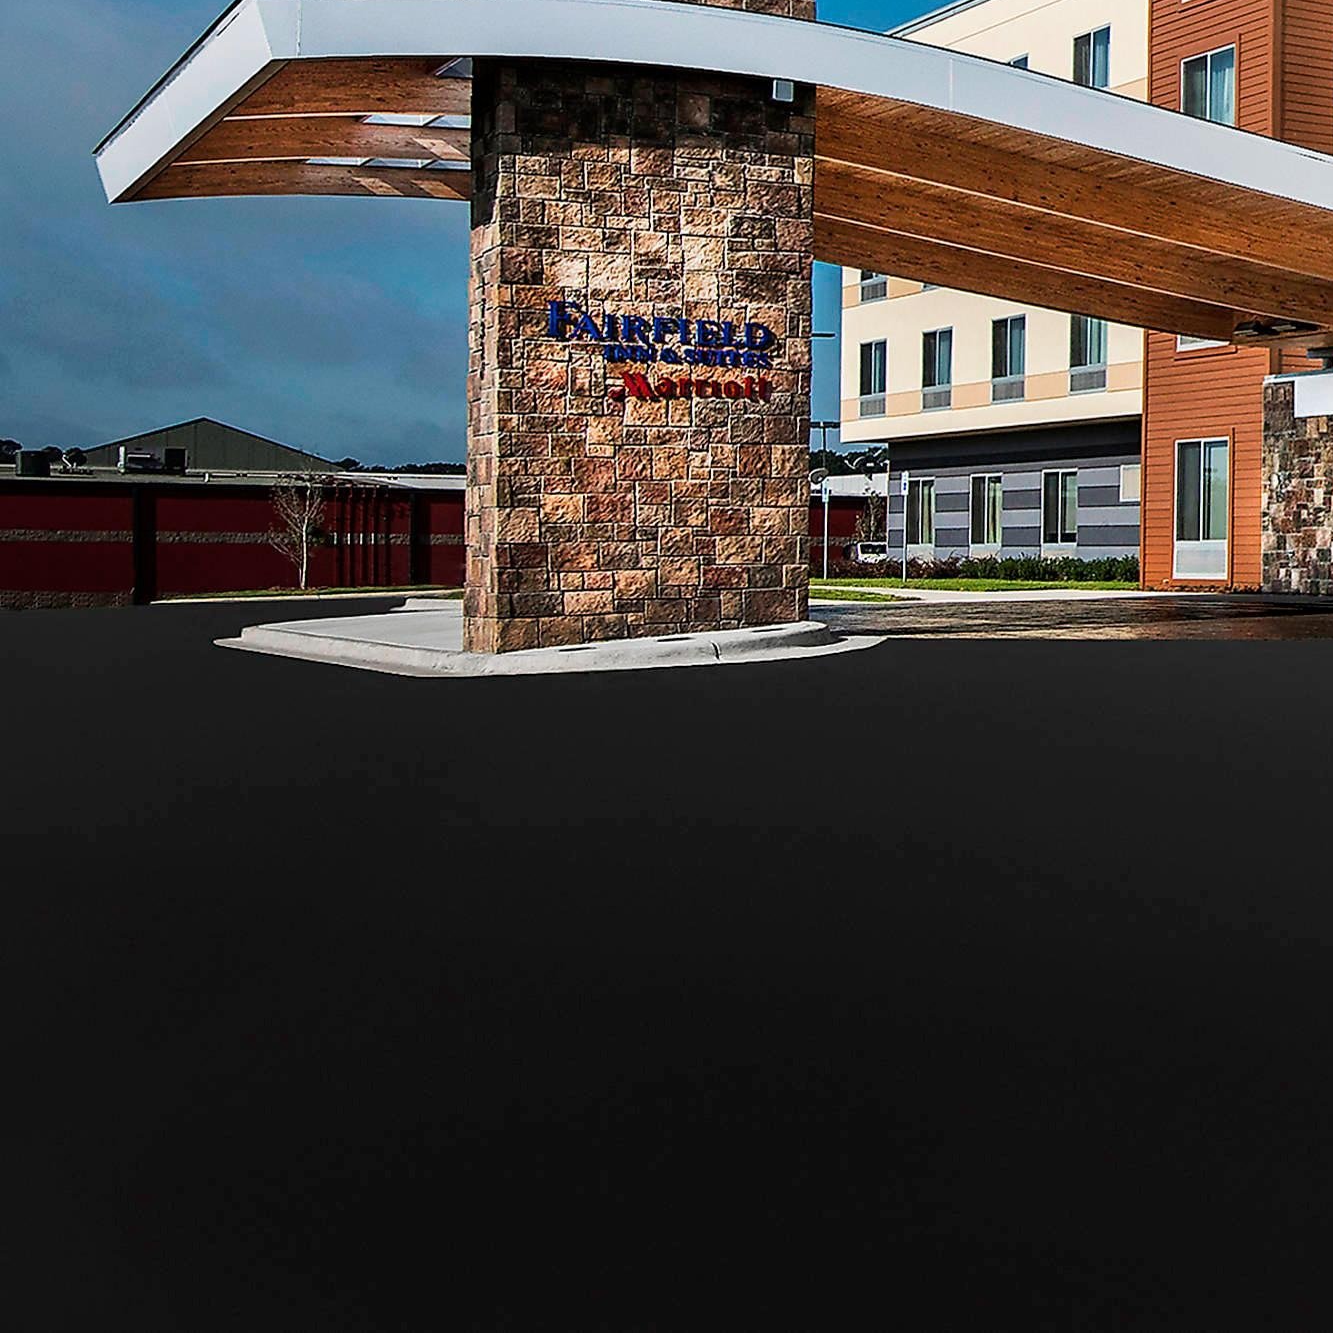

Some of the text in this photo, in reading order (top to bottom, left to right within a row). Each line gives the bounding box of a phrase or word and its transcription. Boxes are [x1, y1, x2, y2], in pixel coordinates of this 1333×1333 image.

[548, 300, 777, 351] FAIRFIELD
[603, 344, 773, 367] INN & SUITES
[608, 370, 773, 403] Marriott
